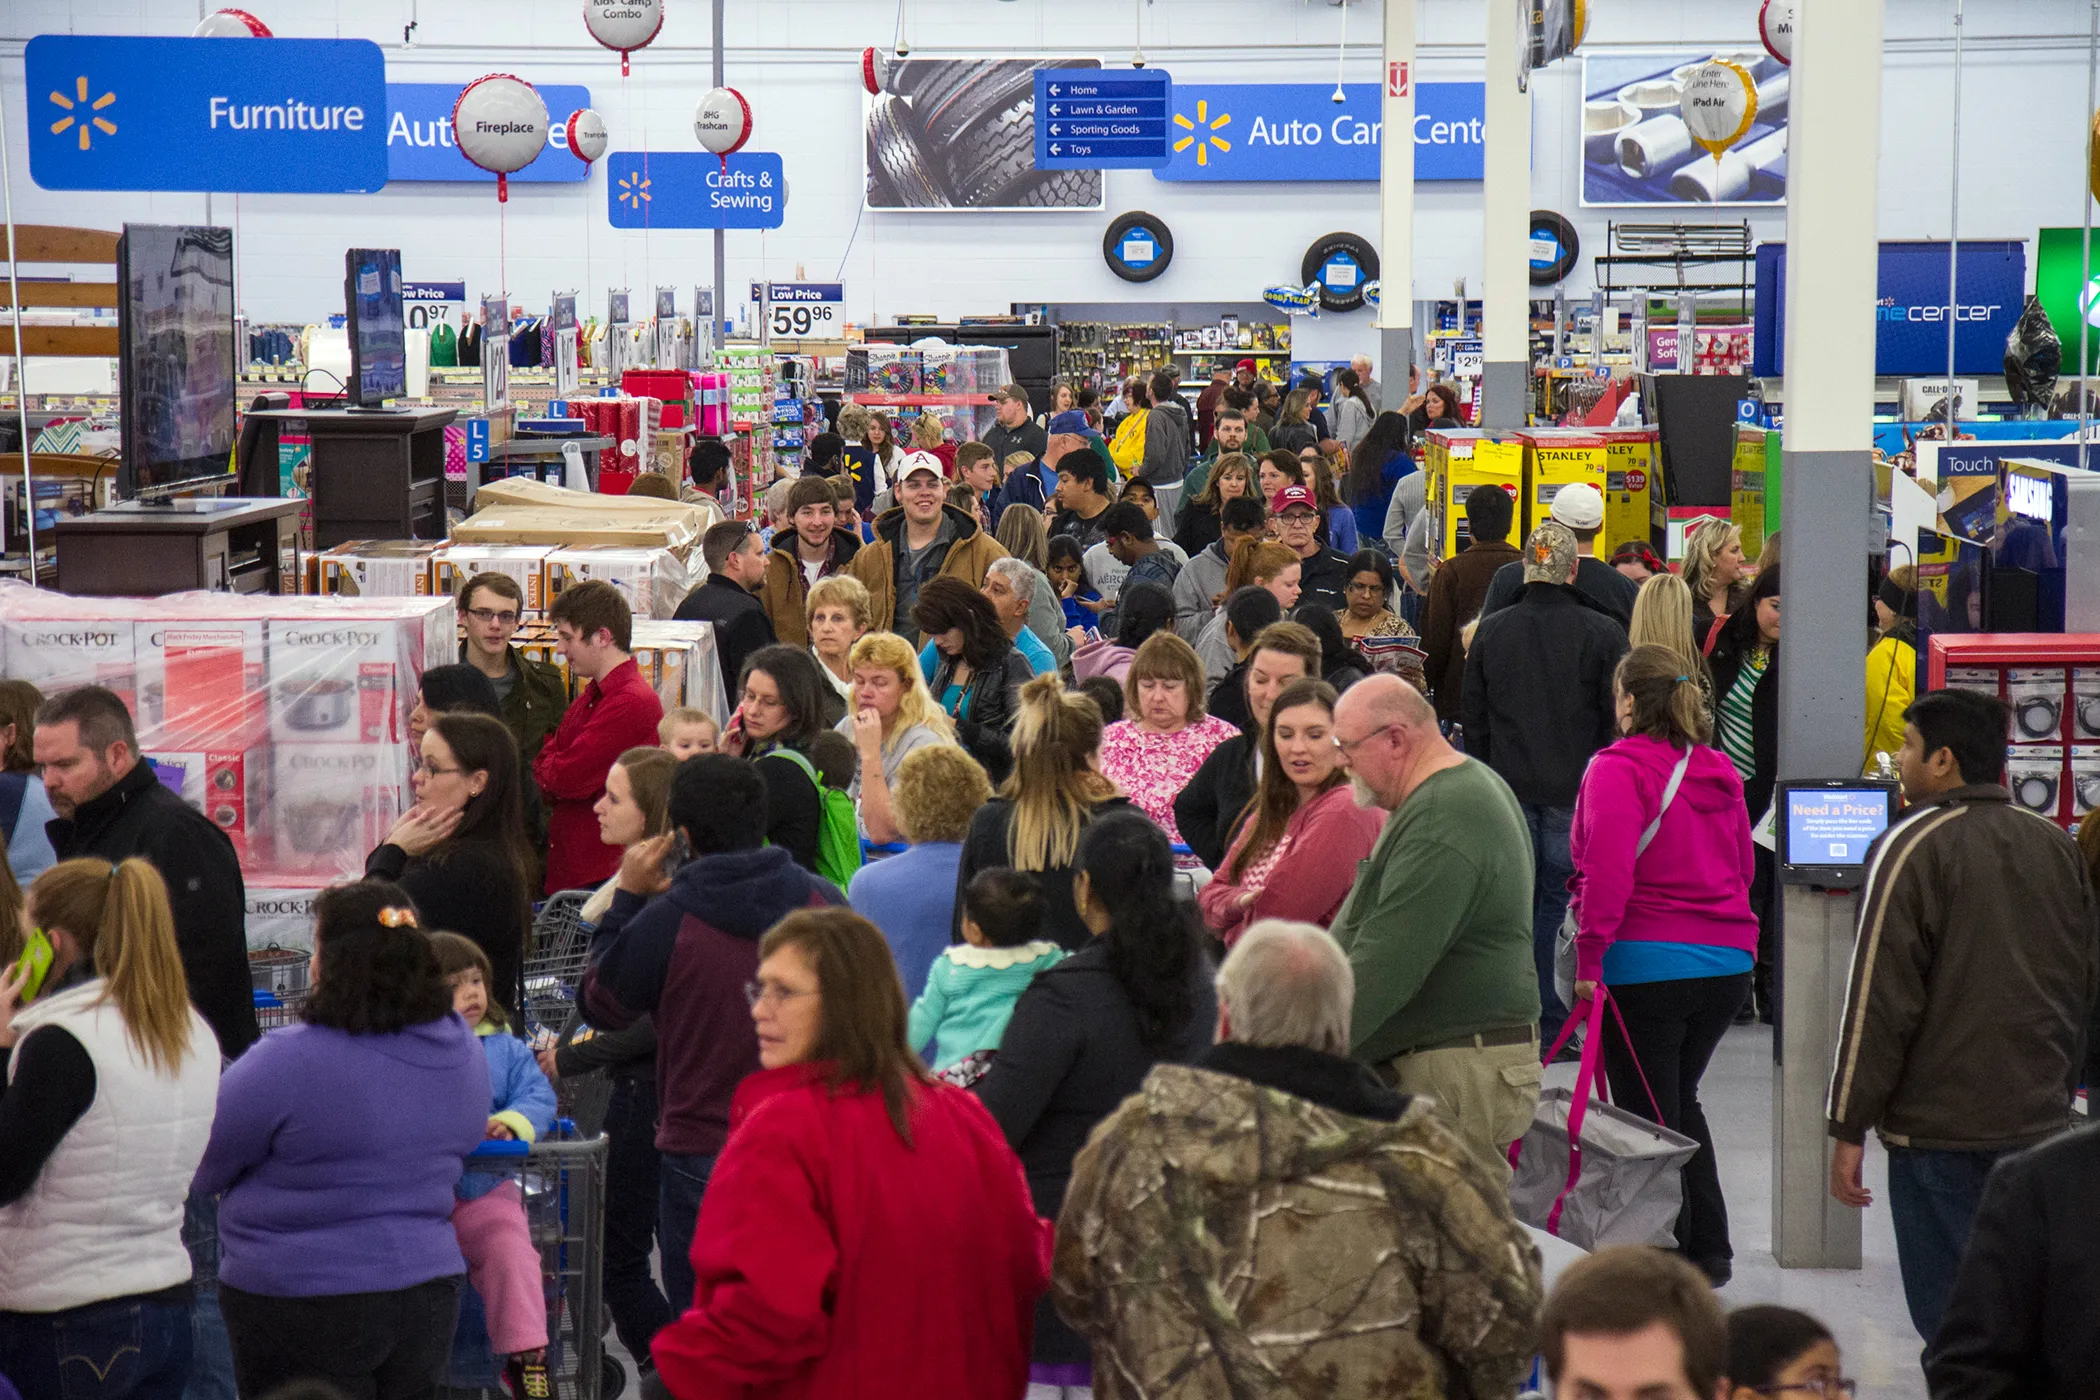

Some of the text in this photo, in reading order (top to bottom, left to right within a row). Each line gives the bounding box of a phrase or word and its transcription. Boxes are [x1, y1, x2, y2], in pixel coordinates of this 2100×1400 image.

[603, 9, 642, 19] Combo
[1701, 70, 1722, 78] Enter
[1070, 86, 1098, 95] Home
[1692, 97, 1725, 107] iPad Air
[210, 97, 365, 131] Furniture
[703, 111, 720, 119] BHG
[1070, 105, 1138, 115] Lawn & Garden
[476, 121, 534, 136] Fireplace
[697, 121, 728, 131] Trashcan
[1070, 124, 1140, 136] Sporting Goods
[1247, 114, 1486, 146] Auto Car Cent
[1070, 144, 1092, 156] Toys
[706, 170, 773, 188] Crafts &
[710, 191, 773, 212] Sewing
[402, 288, 445, 299] ow Price
[771, 290, 823, 300] Low Price
[1263, 292, 1311, 305] GOODYEAR
[1656, 336, 1678, 347] Gen
[868, 352, 897, 364] Sharpie
[923, 352, 952, 365] Sharpie
[1561, 359, 1569, 367] P
[1922, 385, 1963, 394] CALL DTY
[553, 403, 562, 418] L
[472, 422, 483, 439] L
[473, 444, 483, 459] 5
[1539, 451, 1592, 461] STANLEY
[912, 452, 931, 465] A
[1948, 456, 1993, 472] Touch
[1585, 463, 1594, 471] 70
[1626, 475, 1645, 484] $139
[2008, 472, 2053, 521] SAMSUNG
[529, 575, 537, 608] INTEX
[208, 753, 240, 762] Classic
[1793, 804, 1884, 816] Need a Price?
